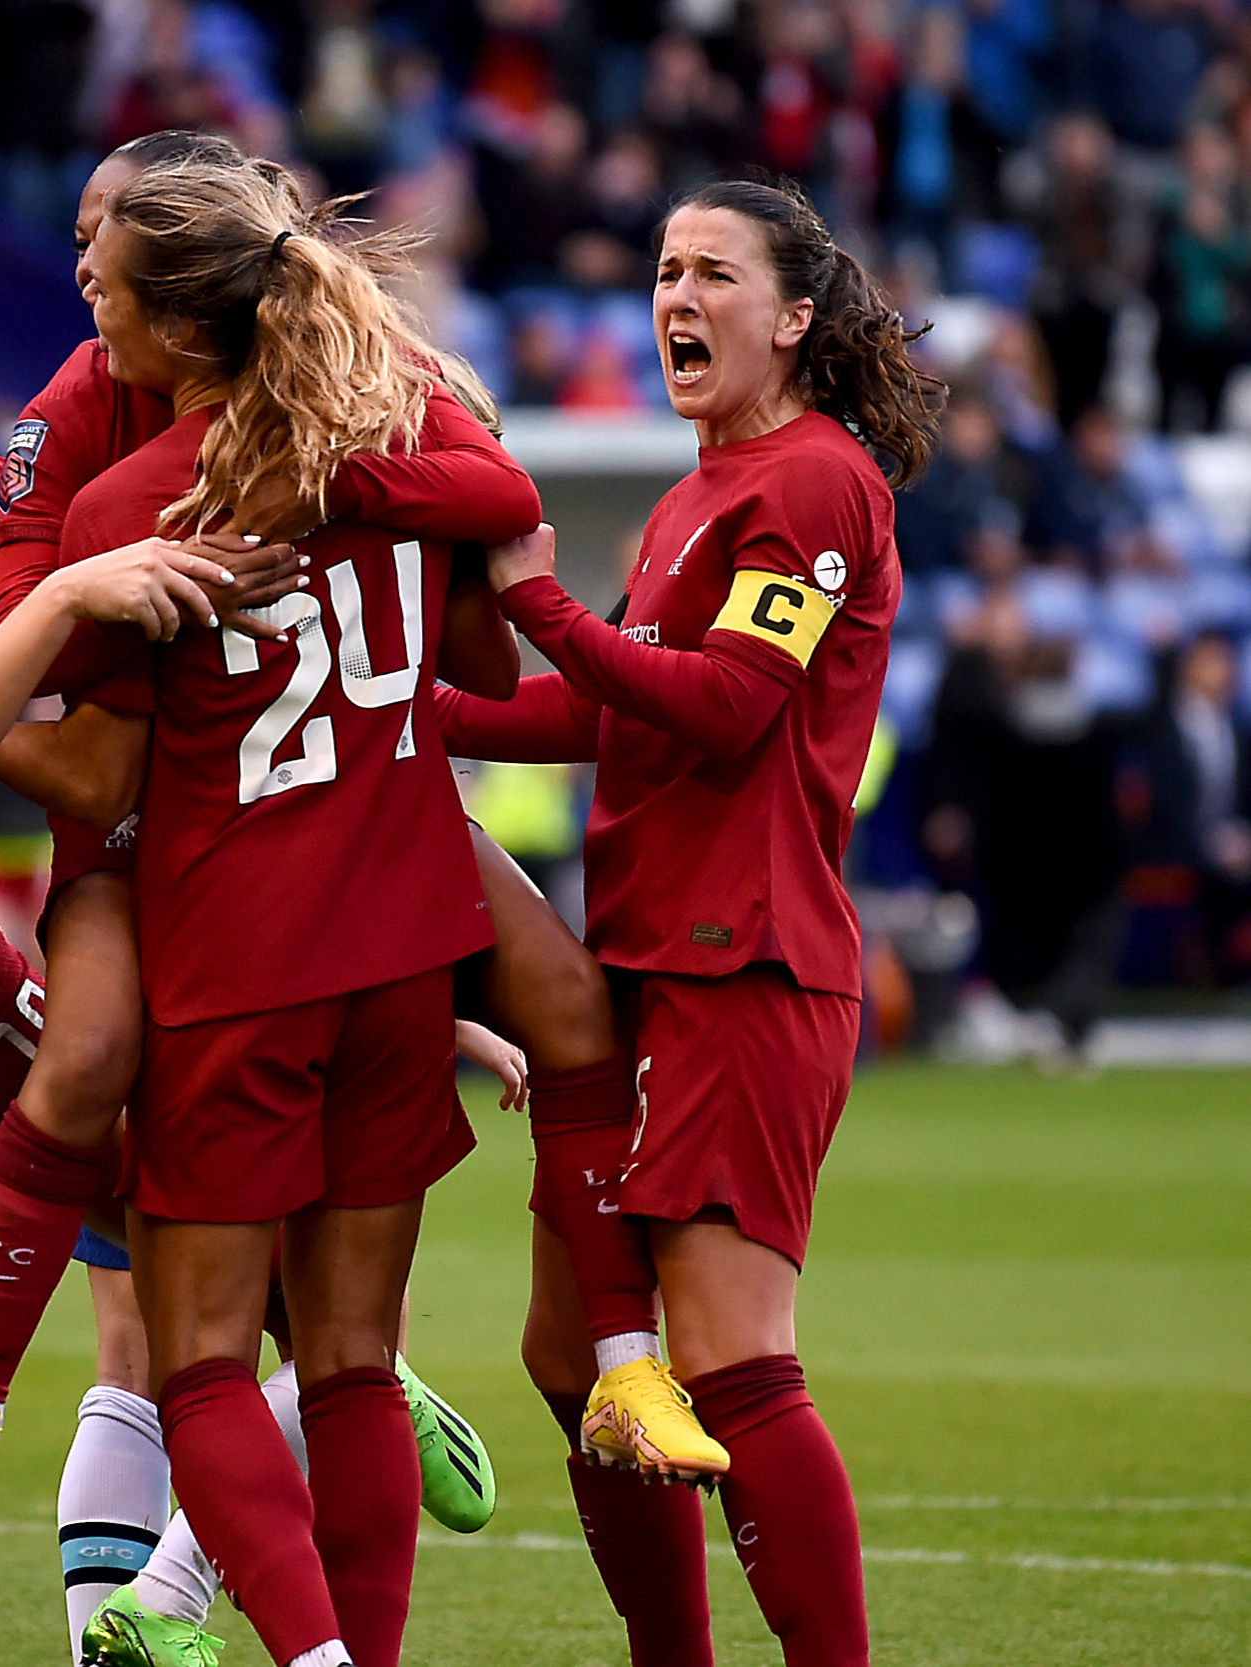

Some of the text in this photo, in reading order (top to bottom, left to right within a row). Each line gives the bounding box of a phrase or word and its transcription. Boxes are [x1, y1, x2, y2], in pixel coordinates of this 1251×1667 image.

[751, 583, 804, 635] C
[222, 540, 423, 804] 24
[79, 1546, 135, 1560] CFC
